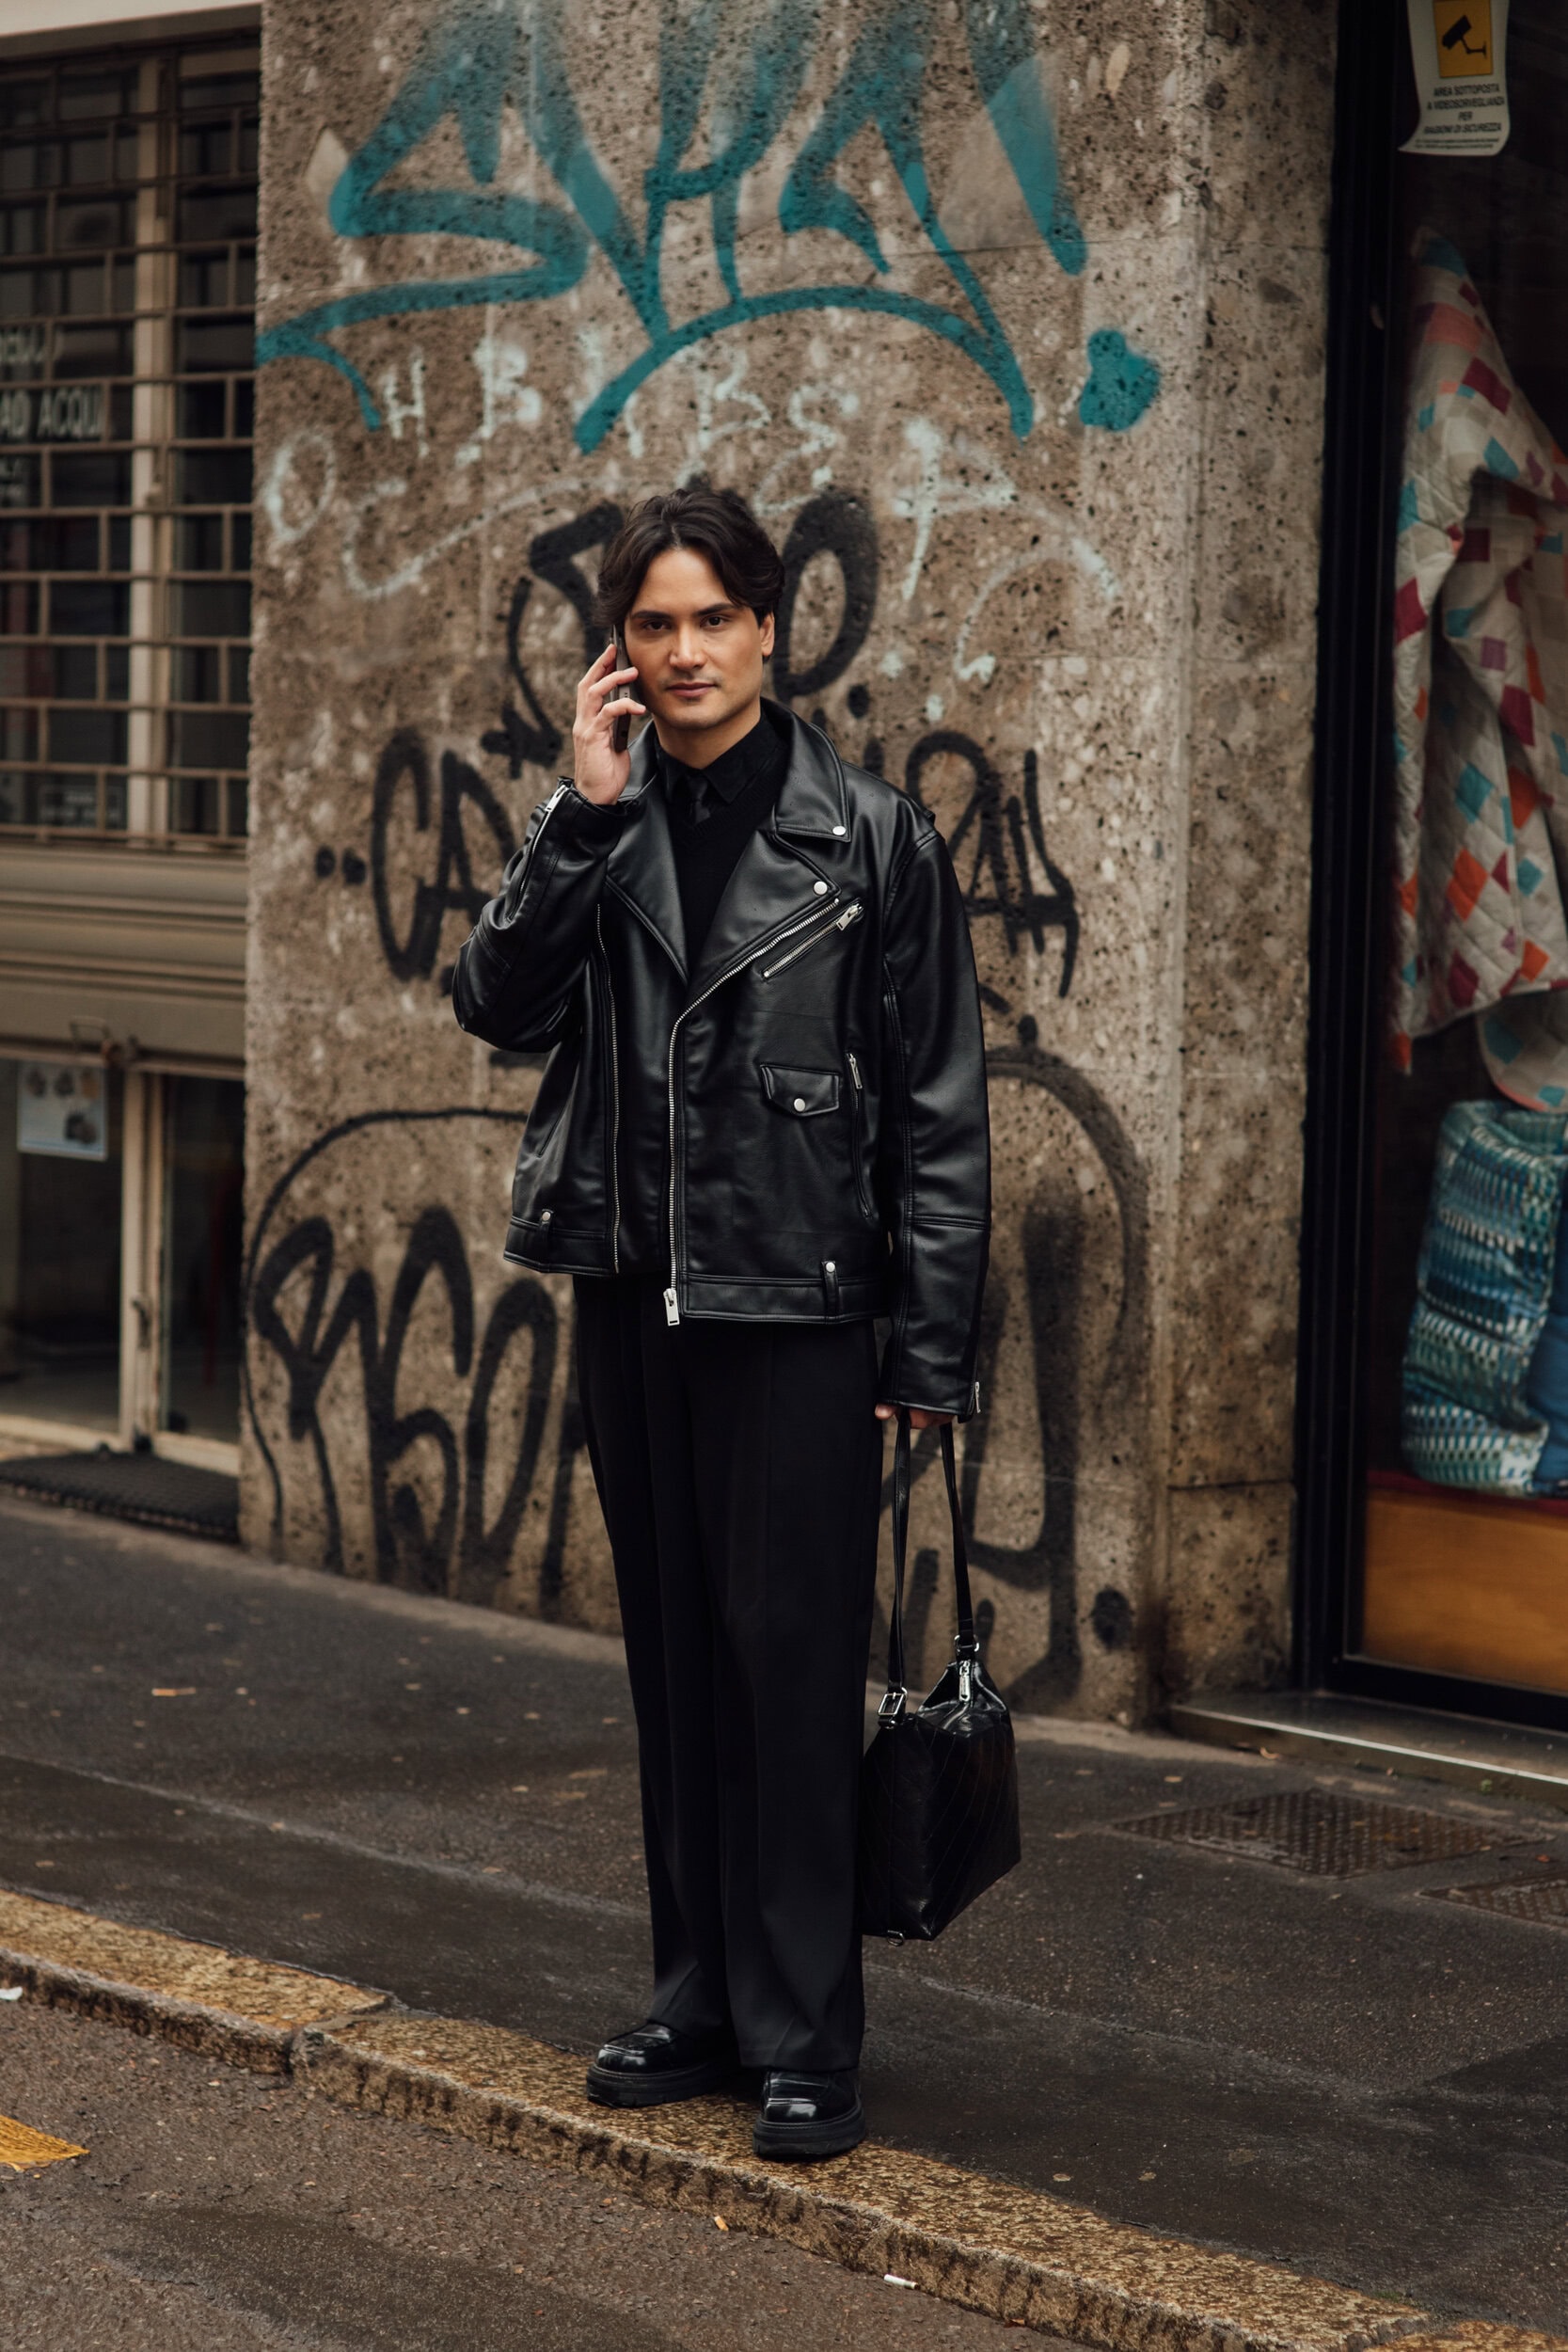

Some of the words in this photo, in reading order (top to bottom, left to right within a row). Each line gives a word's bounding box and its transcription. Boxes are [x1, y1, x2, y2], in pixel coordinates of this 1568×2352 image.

[1433, 87, 1452, 97] AREA
[1454, 84, 1499, 95] SOTTOPOSTA
[1427, 102, 1433, 110] A
[1458, 111, 1473, 120] PER
[1463, 122, 1501, 134] SICUREZZA
